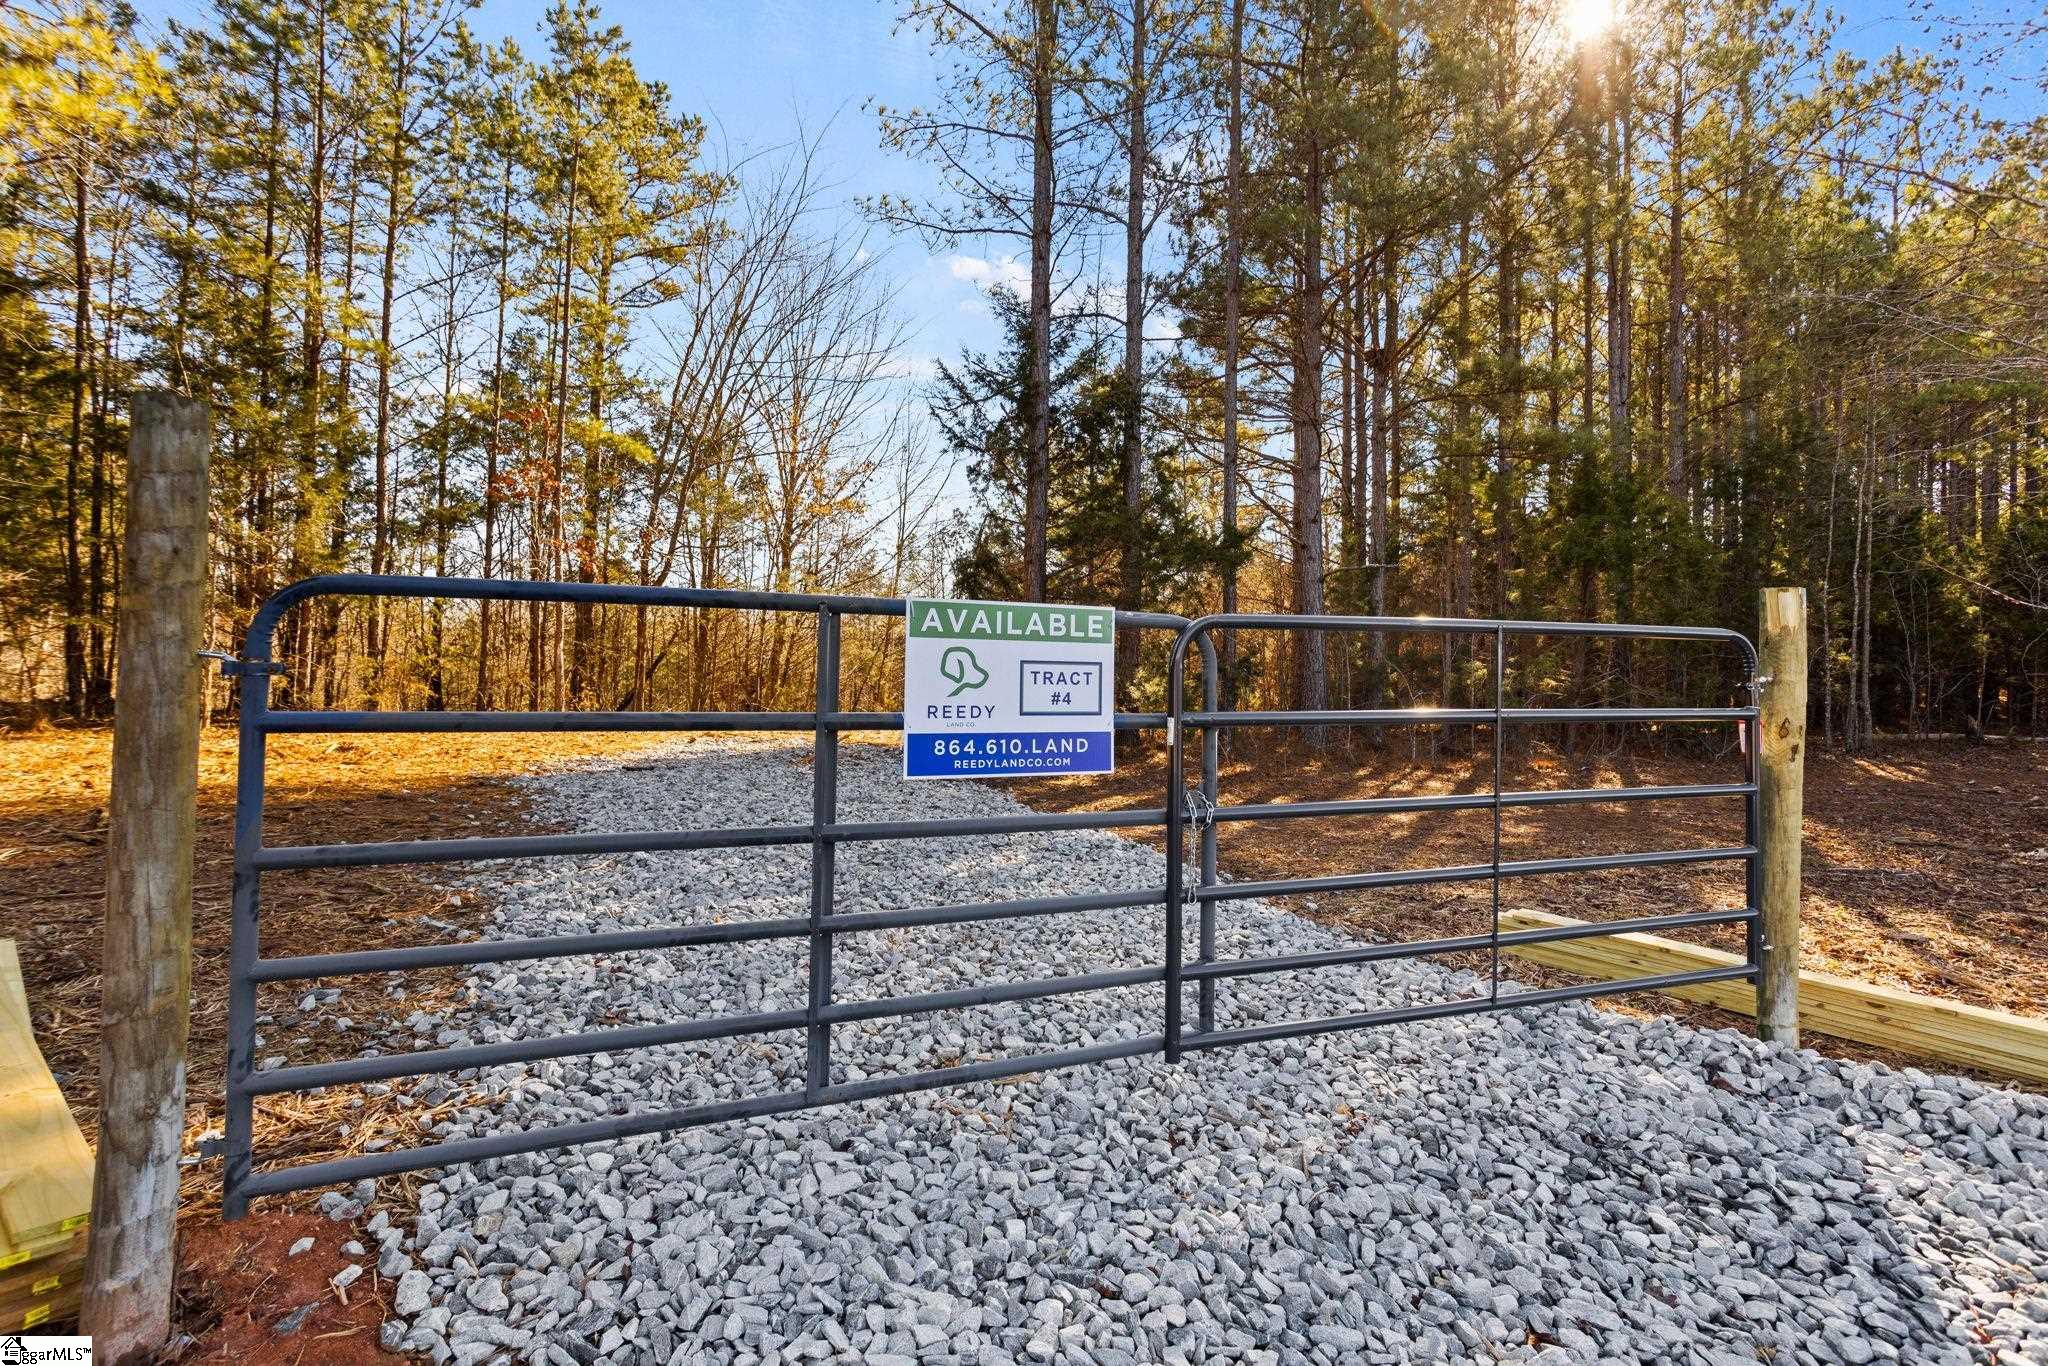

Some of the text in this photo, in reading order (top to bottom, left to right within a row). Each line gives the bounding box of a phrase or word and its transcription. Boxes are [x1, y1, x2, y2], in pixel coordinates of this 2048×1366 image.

[920, 607, 1104, 638] AVAILABLE
[1030, 671, 1093, 686] TRACT
[1050, 691, 1072, 706] #4
[927, 705, 996, 719] REEDY
[934, 738, 1089, 756] 864.610.LAND
[954, 757, 1071, 769] REEDYLANDCO.COM
